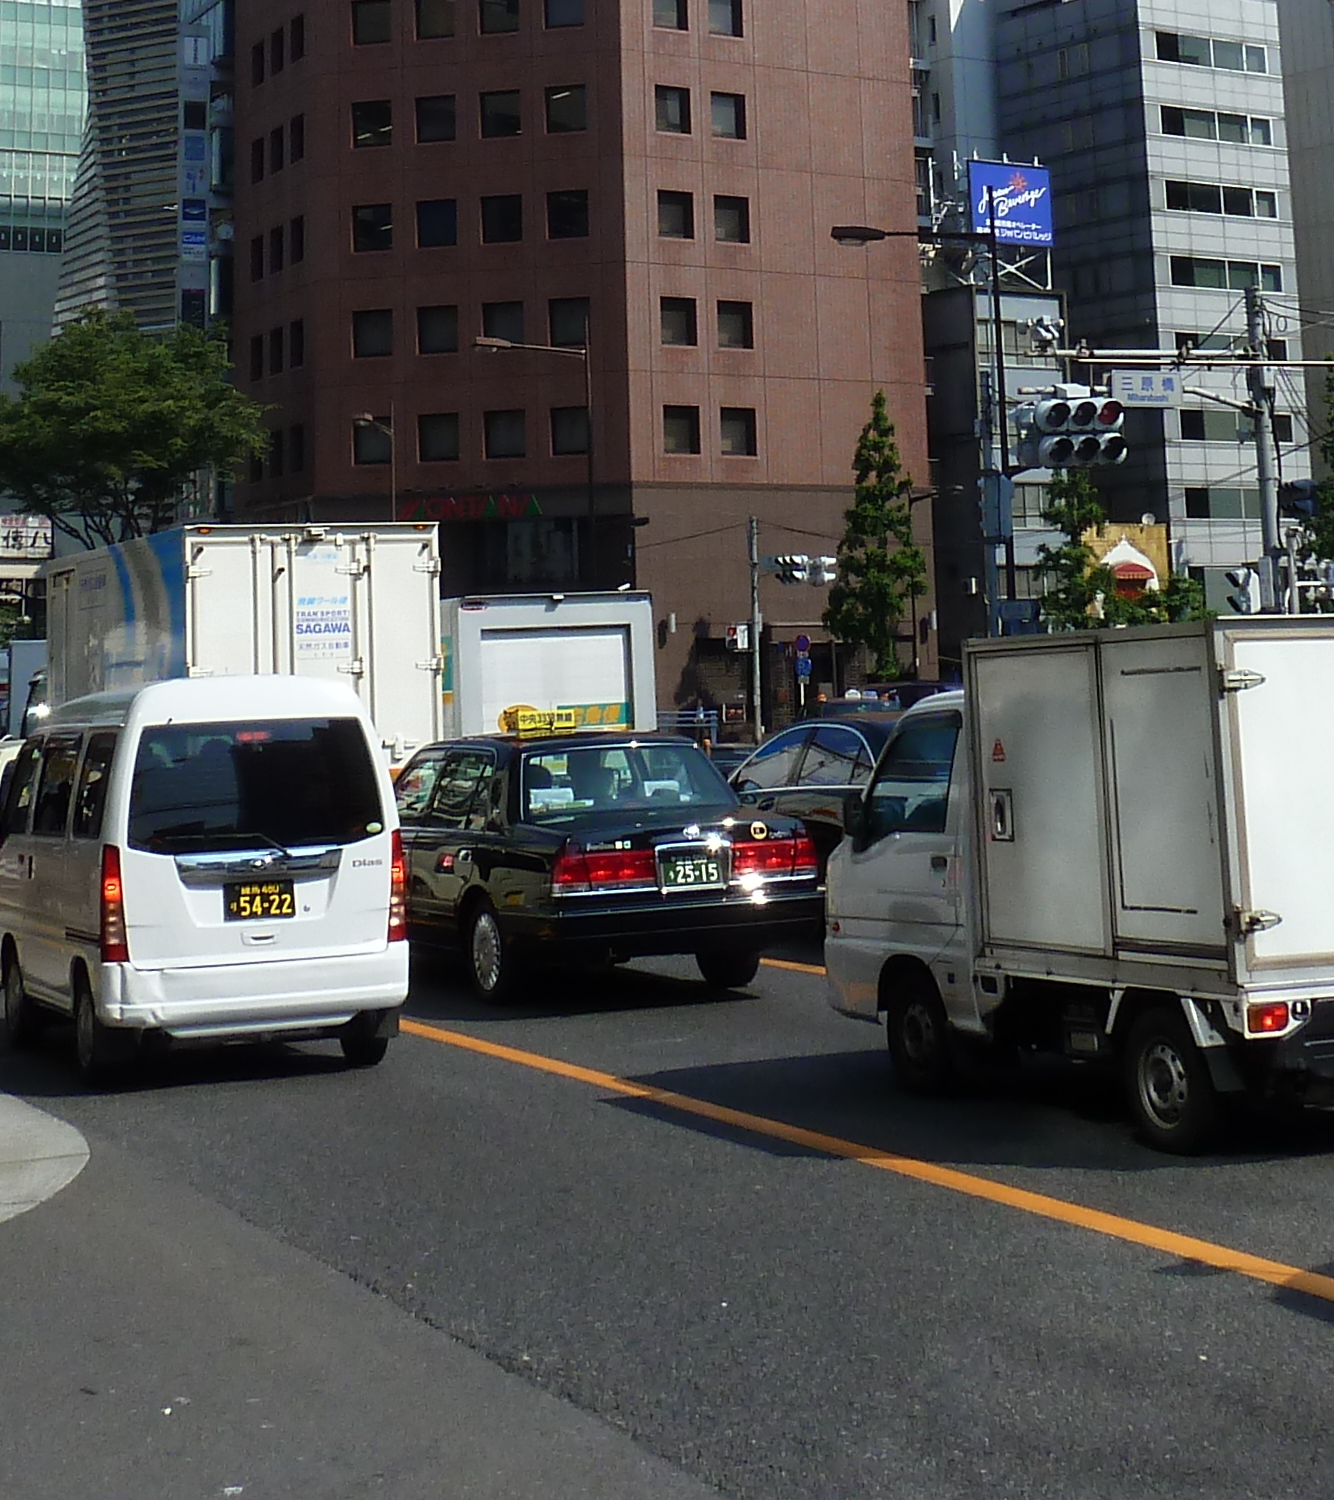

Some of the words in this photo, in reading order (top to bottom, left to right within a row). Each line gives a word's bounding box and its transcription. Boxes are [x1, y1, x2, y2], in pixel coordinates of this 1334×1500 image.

[295, 623, 351, 634] SAGAWA
[675, 862, 718, 883] 25-15
[239, 893, 293, 917] 54-22
